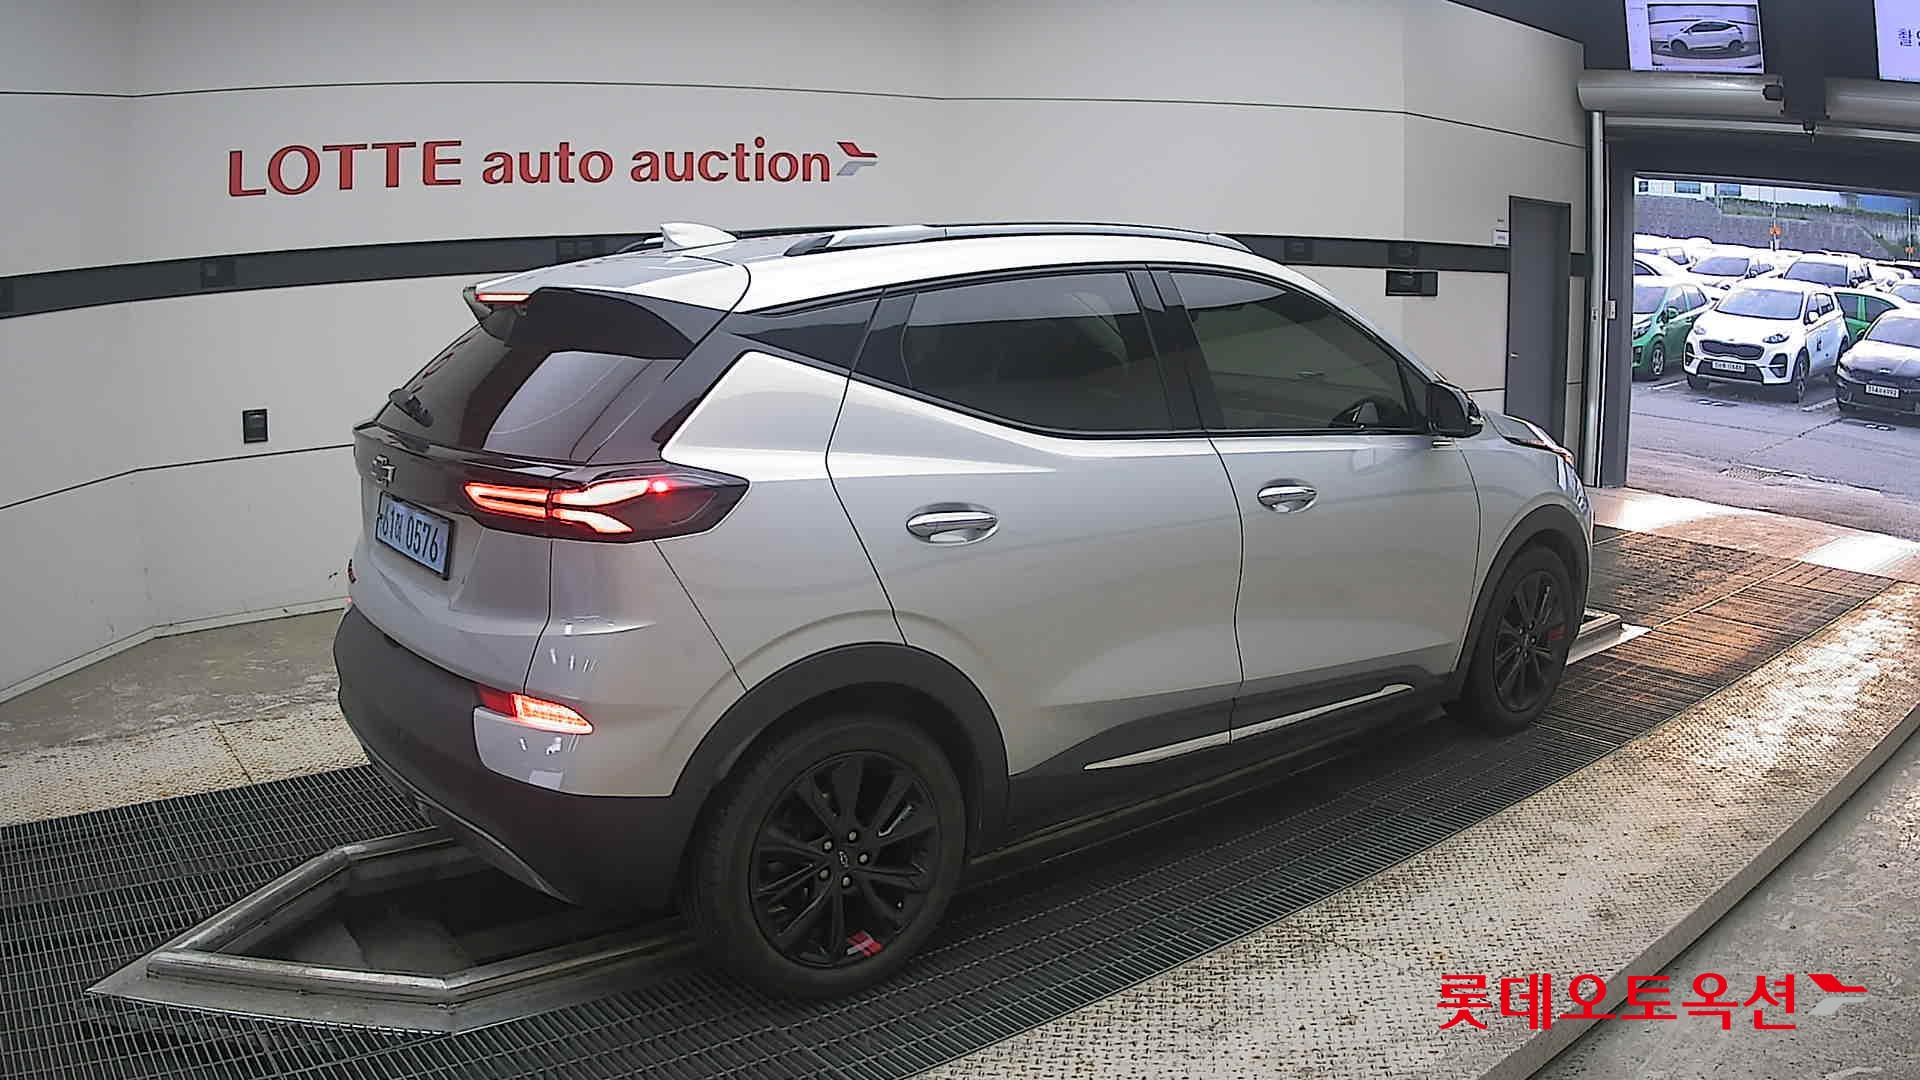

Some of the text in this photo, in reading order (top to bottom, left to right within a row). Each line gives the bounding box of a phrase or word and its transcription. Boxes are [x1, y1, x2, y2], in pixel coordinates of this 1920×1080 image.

[228, 137, 832, 197] LOTTE auto auction
[406, 516, 438, 562] 0576
